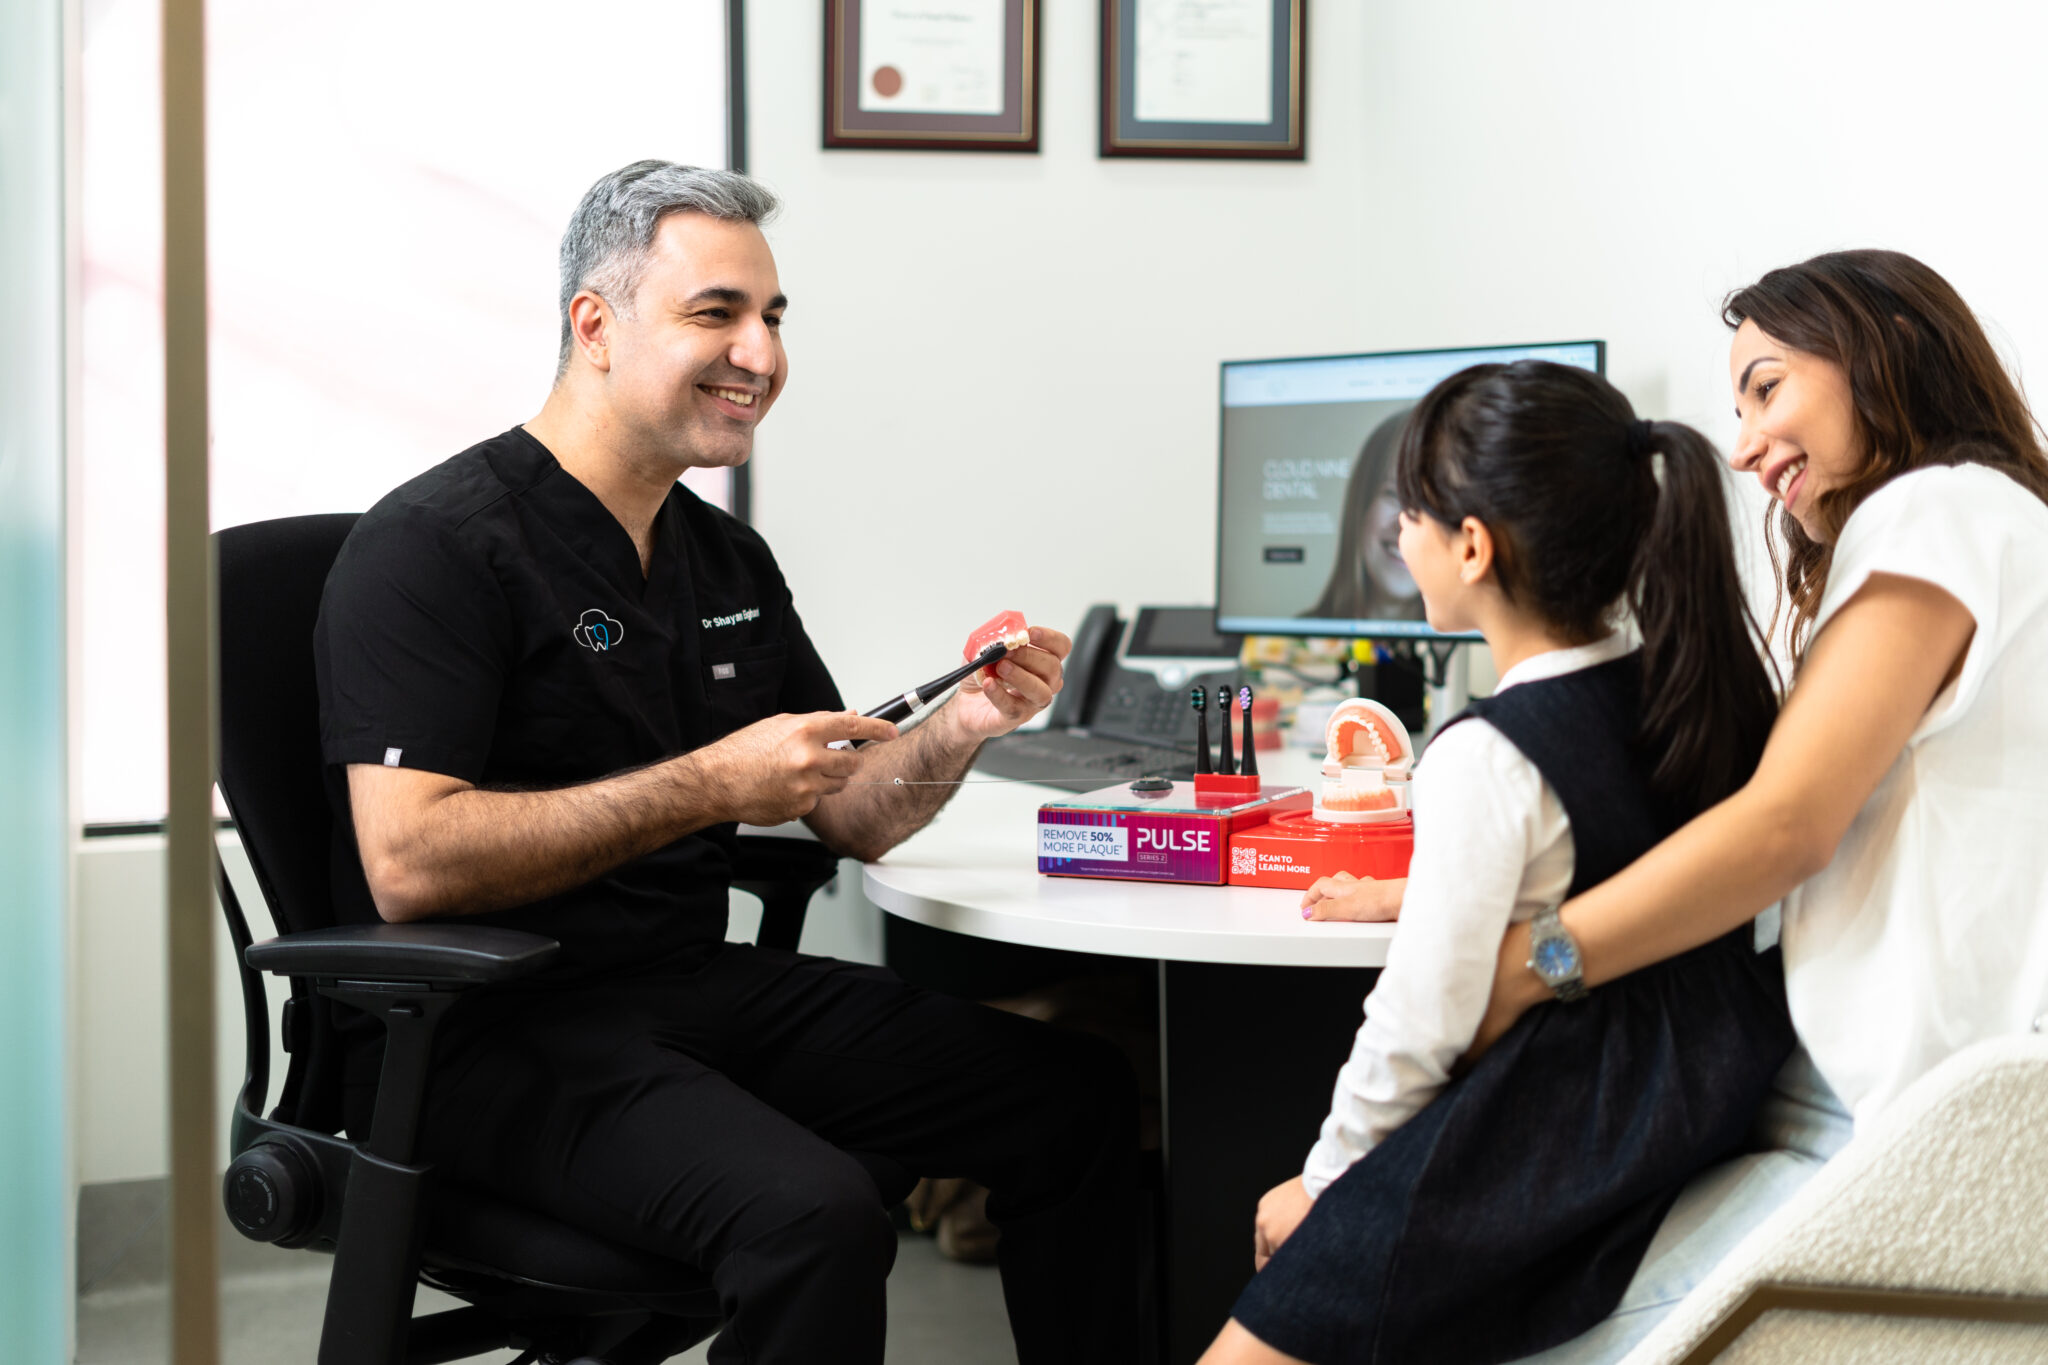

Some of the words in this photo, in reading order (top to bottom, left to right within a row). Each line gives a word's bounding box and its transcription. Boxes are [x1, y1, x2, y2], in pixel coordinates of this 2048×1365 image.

[1043, 829, 1087, 842] REMOVE
[1090, 831, 1114, 843] 50%
[1137, 827, 1211, 852] PULSE
[1043, 842, 1075, 853] MORE
[1140, 854, 1160, 862] SERIES
[1258, 854, 1280, 863] SCAN
[1281, 856, 1293, 864] TO
[1258, 863, 1286, 872] LEARN
[1286, 865, 1311, 874] MORE
